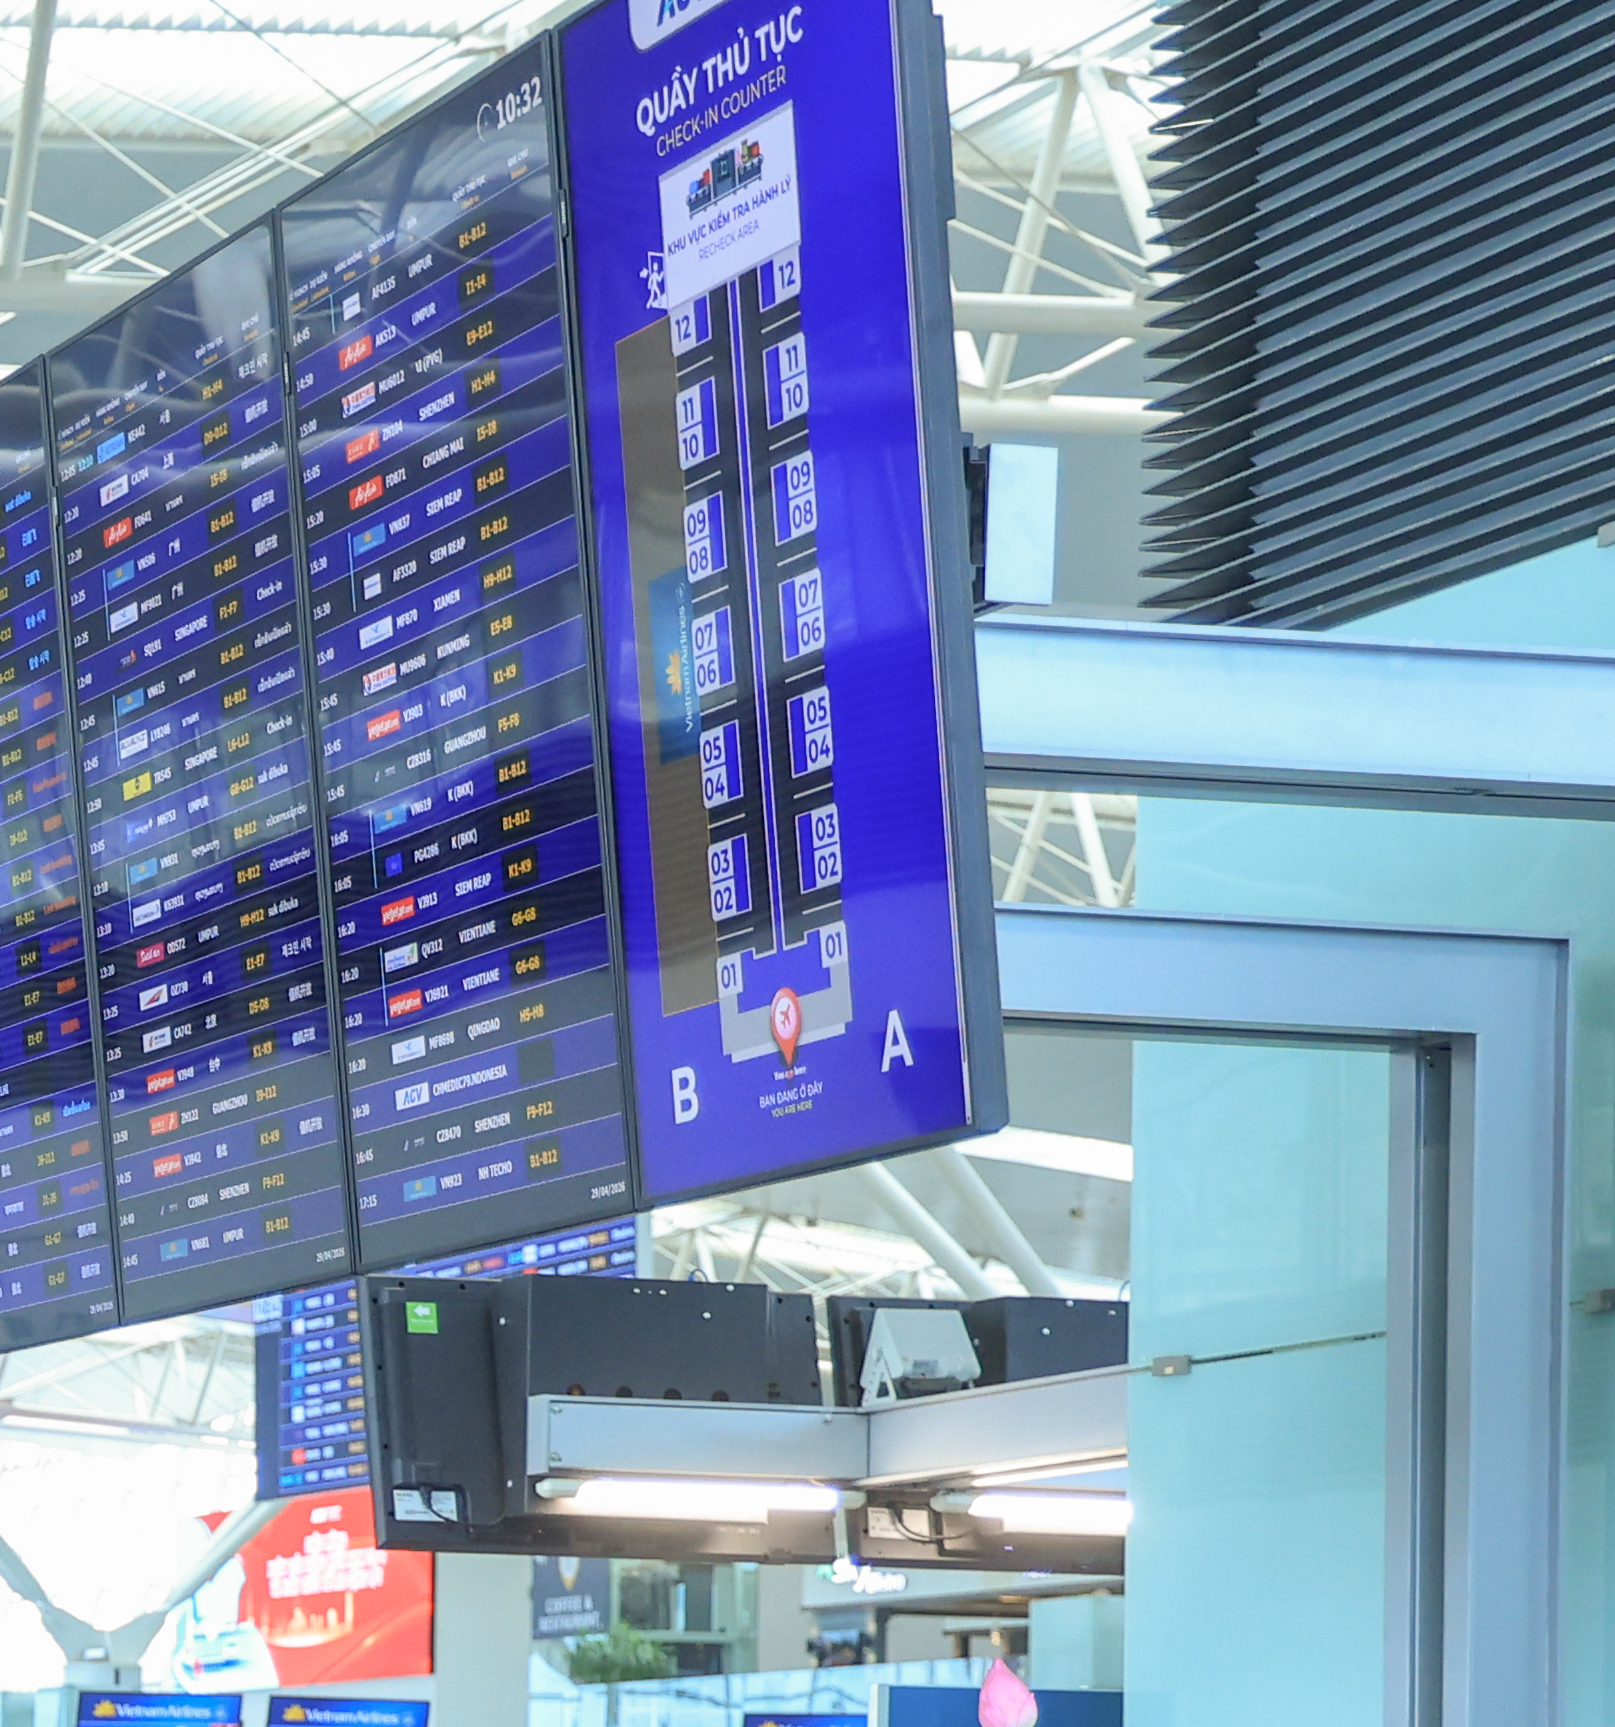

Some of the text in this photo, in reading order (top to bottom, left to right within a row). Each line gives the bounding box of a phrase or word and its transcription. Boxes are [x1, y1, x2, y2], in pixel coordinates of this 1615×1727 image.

[636, 66, 698, 136] QUẦY
[703, 28, 750, 94] THỦ
[754, 6, 804, 62] TỤC
[495, 76, 542, 130] 10:32
[657, 65, 787, 157] CHECK-IN COUNTER
[668, 174, 791, 257] KHU VỰC KIỂM TRA HÀNH LÝ
[699, 220, 760, 260] RECHECK AREA
[292, 222, 486, 347] 14:45 UMPUR B1-B12
[779, 261, 795, 287] 12
[676, 316, 691, 341] 12
[787, 345, 799, 371] 11
[419, 370, 496, 420] SHENZHEN H1-H4
[786, 383, 803, 411] 10
[682, 397, 694, 423] 11
[682, 434, 698, 459] 10
[306, 437, 464, 529] 15:20 CHIANG MAI
[791, 461, 810, 488] 09
[310, 468, 504, 574] 15:30 SIEM REAP B1-B12
[687, 508, 705, 534] 09
[793, 500, 813, 528] 08
[392, 560, 416, 582] AF3320
[690, 547, 708, 574] 08
[432, 589, 460, 612] XIAMEN
[799, 580, 818, 607] 07
[174, 615, 208, 642] SINGAPORE
[437, 615, 512, 659] KUNMING E5-E8
[695, 622, 713, 648] 07
[801, 619, 820, 646] 06
[697, 660, 716, 687] 06
[324, 664, 516, 757] 15:45 K1-K9
[807, 697, 827, 724] 05
[444, 713, 519, 754] GUANGZHOU F5-F8
[703, 736, 721, 763] 05
[808, 735, 830, 762] 04
[705, 773, 725, 800] 04
[816, 814, 835, 841] 03
[711, 849, 729, 875] 03
[818, 852, 838, 879] 02
[338, 872, 491, 939] 16:20 SIEM REAP
[714, 886, 733, 913] 02
[459, 920, 496, 944] VIENTIANE
[825, 932, 841, 958] 01
[721, 964, 736, 988] 01
[468, 1018, 500, 1040] QINGDAO
[881, 1010, 914, 1072] A
[672, 1067, 698, 1124] B
[356, 1101, 552, 1165] 16:45 SHENZHEN F9-F12
[359, 1195, 377, 1209] 17:15
[478, 1165, 489, 1180] NH
[490, 1160, 512, 1178] TECHO
[530, 1150, 557, 1168] B1-B12
[590, 1182, 626, 1199] 29/04/2026
